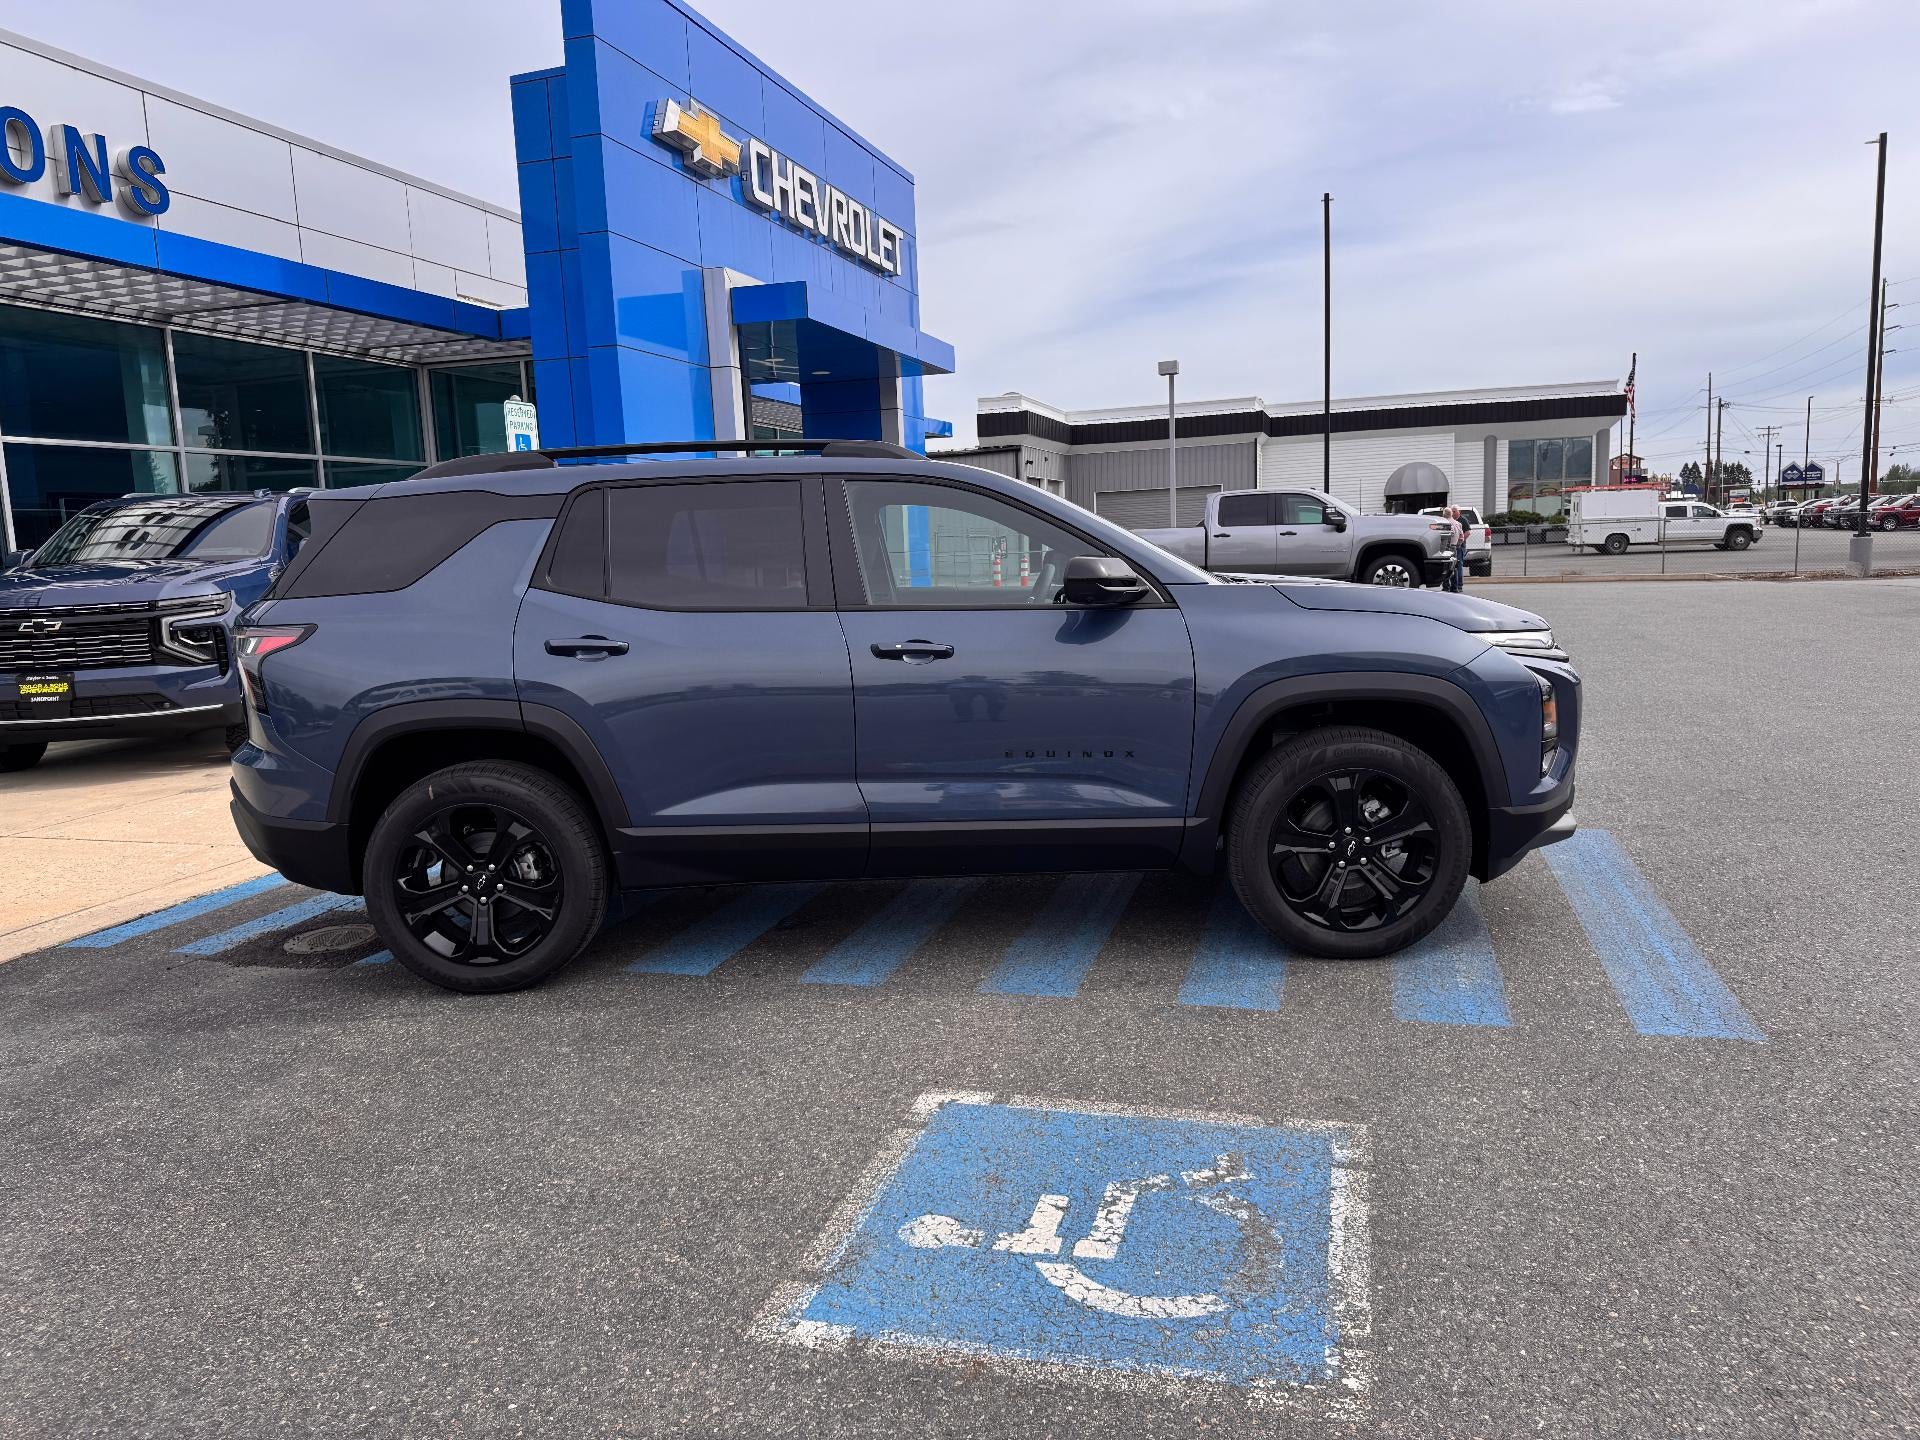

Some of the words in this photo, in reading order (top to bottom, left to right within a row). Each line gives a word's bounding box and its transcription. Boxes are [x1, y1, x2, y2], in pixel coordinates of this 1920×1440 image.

[748, 136, 904, 277] CHEVROLET
[509, 420, 533, 431] PARKING
[1004, 750, 1136, 760] EQUINOX
